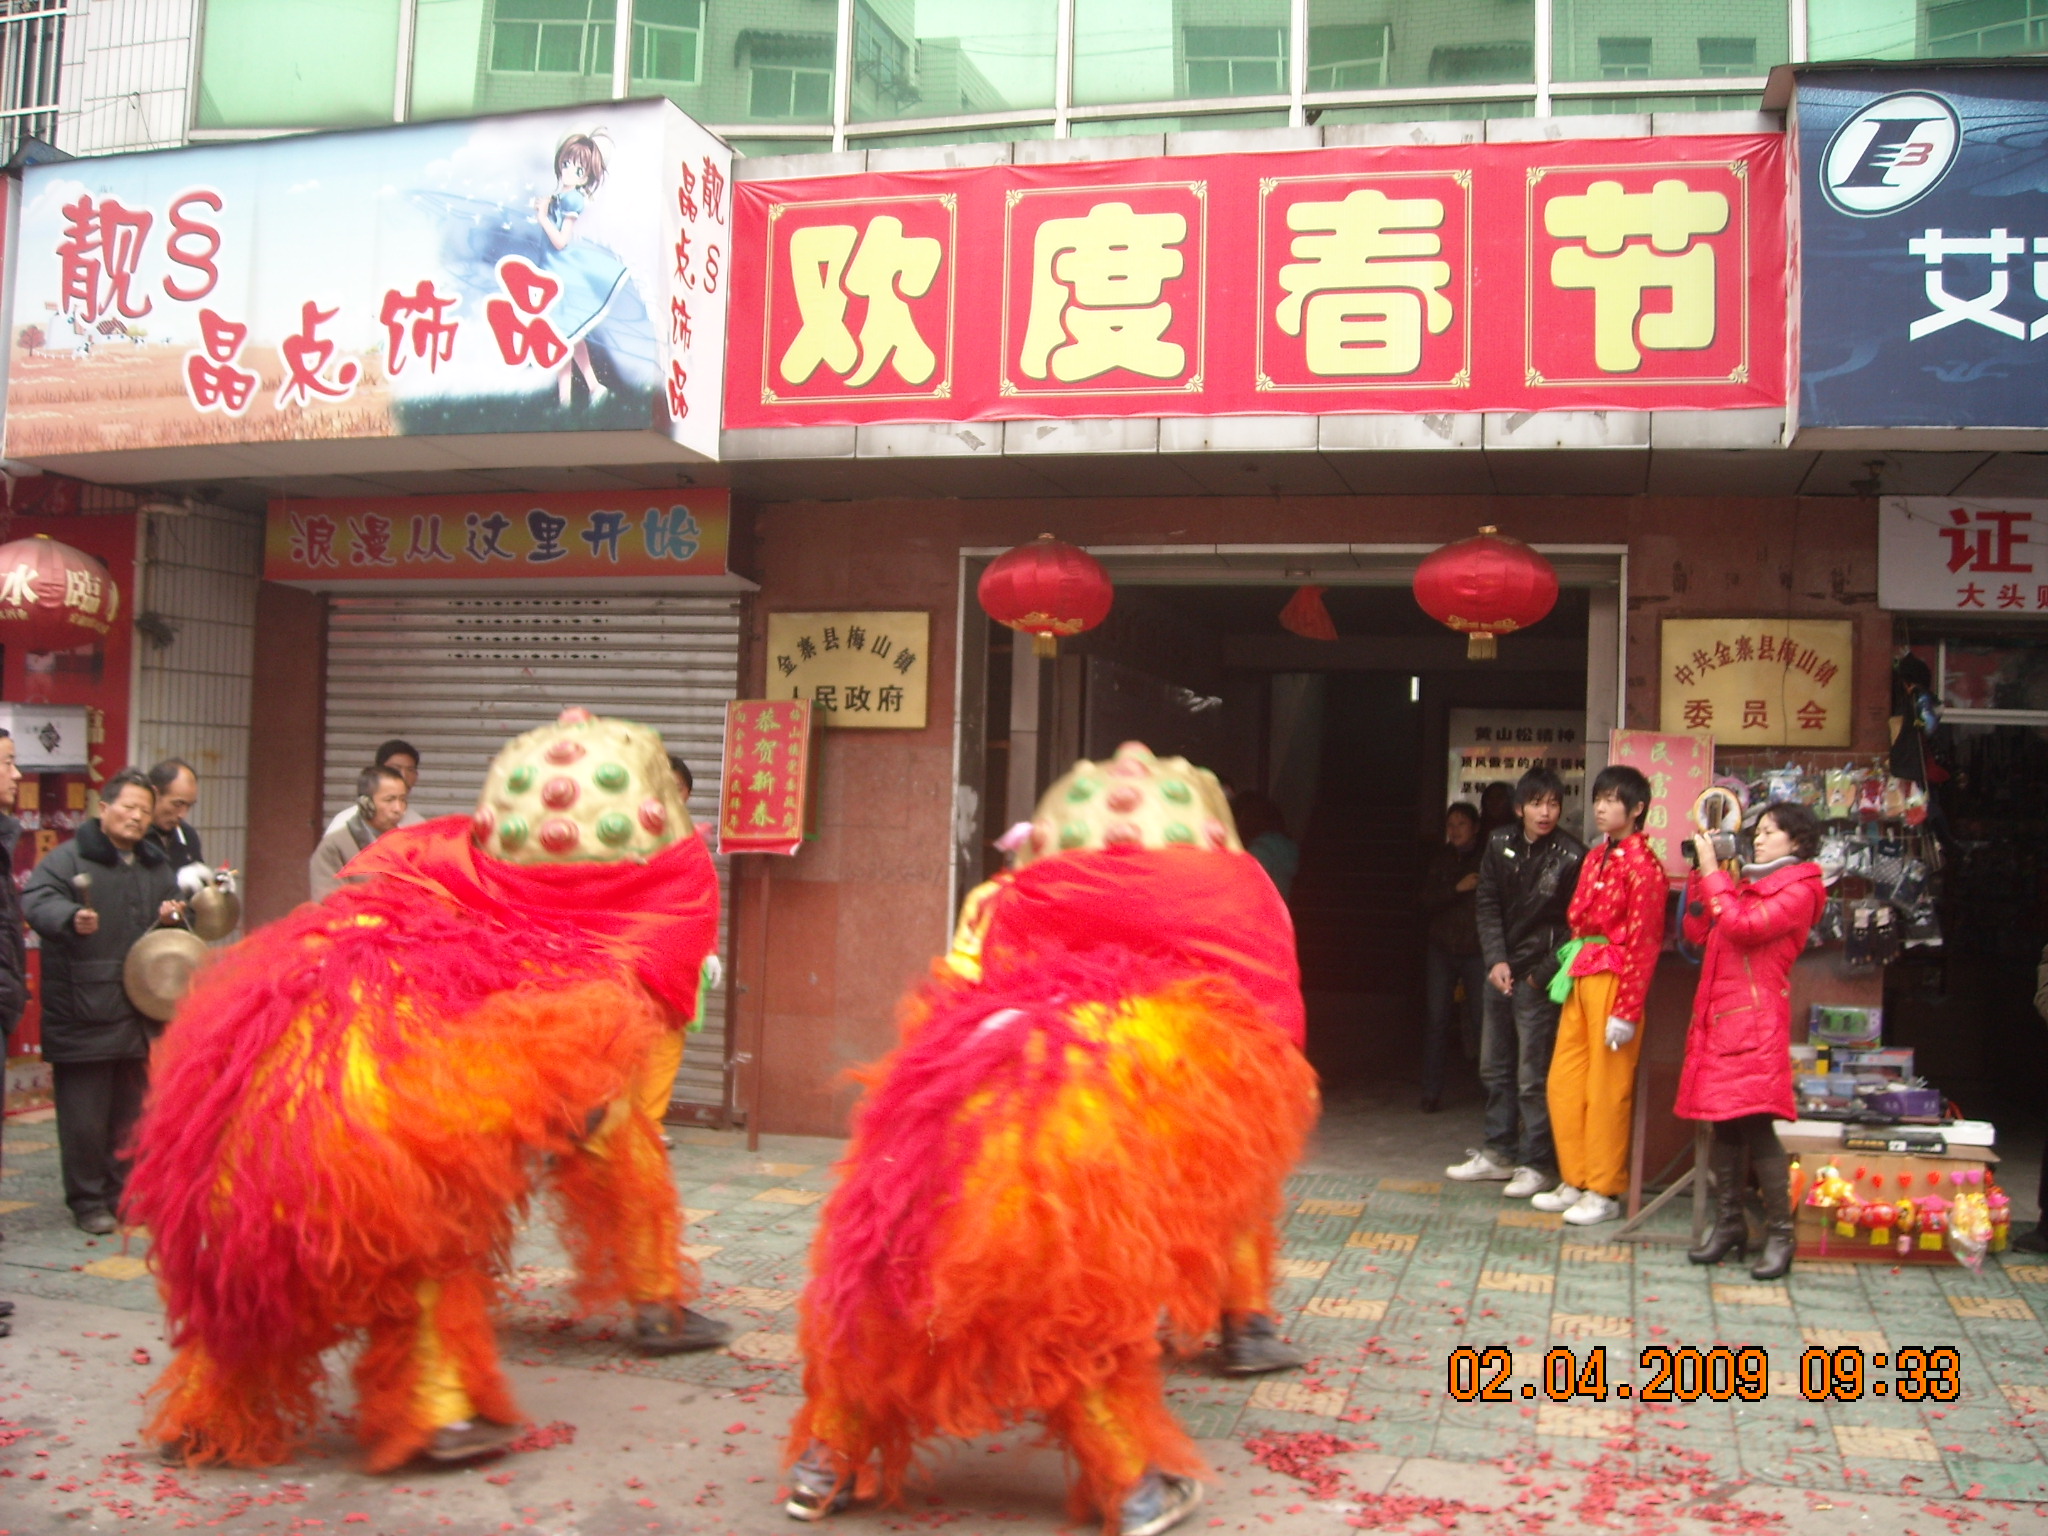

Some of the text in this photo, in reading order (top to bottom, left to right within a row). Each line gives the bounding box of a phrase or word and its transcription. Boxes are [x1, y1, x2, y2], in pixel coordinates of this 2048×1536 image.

[779, 178, 1731, 388] 欢度春节
[290, 506, 700, 568] 浪漫从这里开始
[1939, 508, 2033, 574] 证
[777, 625, 916, 677] 金寨县梅山镇
[1674, 634, 1839, 688] 中共金寨县梅山镇
[1475, 726, 1576, 743] 黄山松精神
[1684, 699, 1827, 730] 委员会
[748, 707, 781, 828] 恭贺新春
